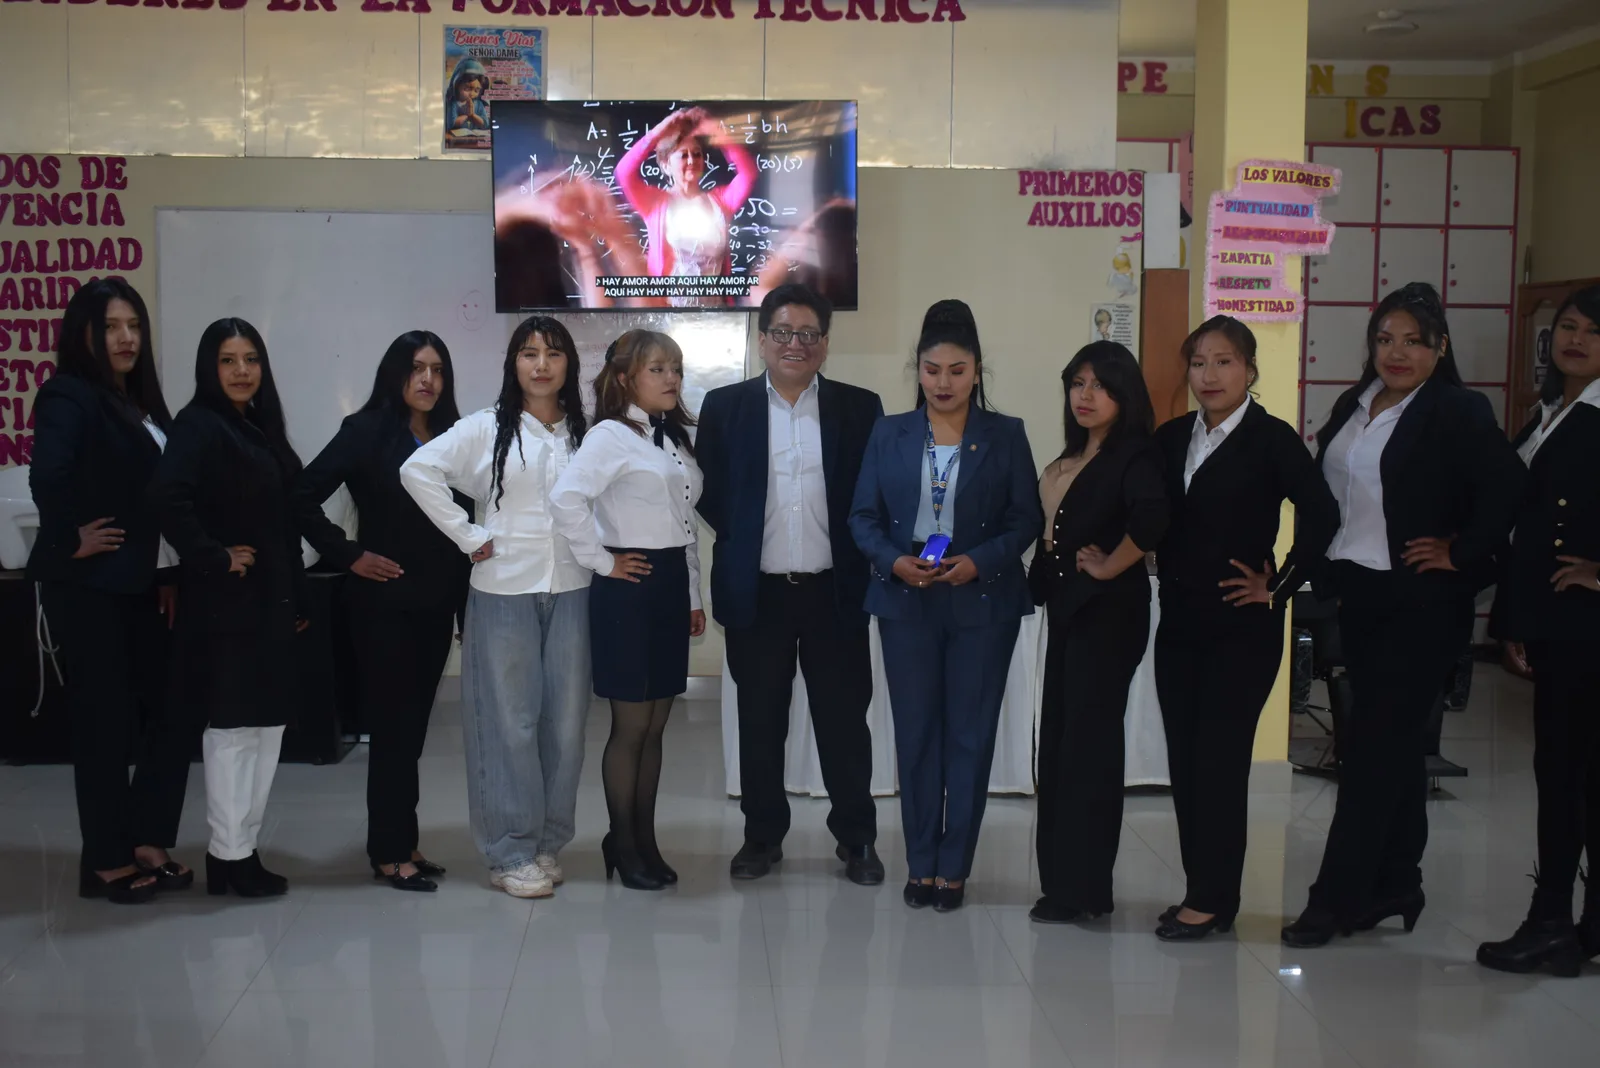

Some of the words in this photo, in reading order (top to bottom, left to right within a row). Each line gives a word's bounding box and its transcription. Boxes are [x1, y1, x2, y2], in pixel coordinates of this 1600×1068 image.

[79, 156, 128, 190] DE
[1243, 168, 1269, 181] LOS
[1272, 169, 1331, 188] VALORES
[1018, 170, 1143, 197] PRIMEROS
[1027, 201, 1142, 227] AUXILIOS
[1224, 200, 1310, 217] PUNTUALIDAD
[1219, 252, 1273, 266] EMPATIA
[602, 277, 620, 286] HAY
[622, 277, 648, 286] AMOR
[650, 277, 676, 286] AMOR
[700, 276, 718, 285] HAY
[719, 276, 746, 285] AMOR
[747, 276, 759, 285] AR
[1217, 277, 1271, 290] RESPETO
[0, 275, 128, 311] ARID
[626, 287, 644, 296] HAY
[646, 287, 664, 296] HAY
[666, 287, 684, 296] HAY
[686, 287, 704, 296] HAY
[706, 287, 724, 296] HAY
[725, 287, 744, 296] HAY
[1216, 299, 1295, 313] HONESTIDAD
